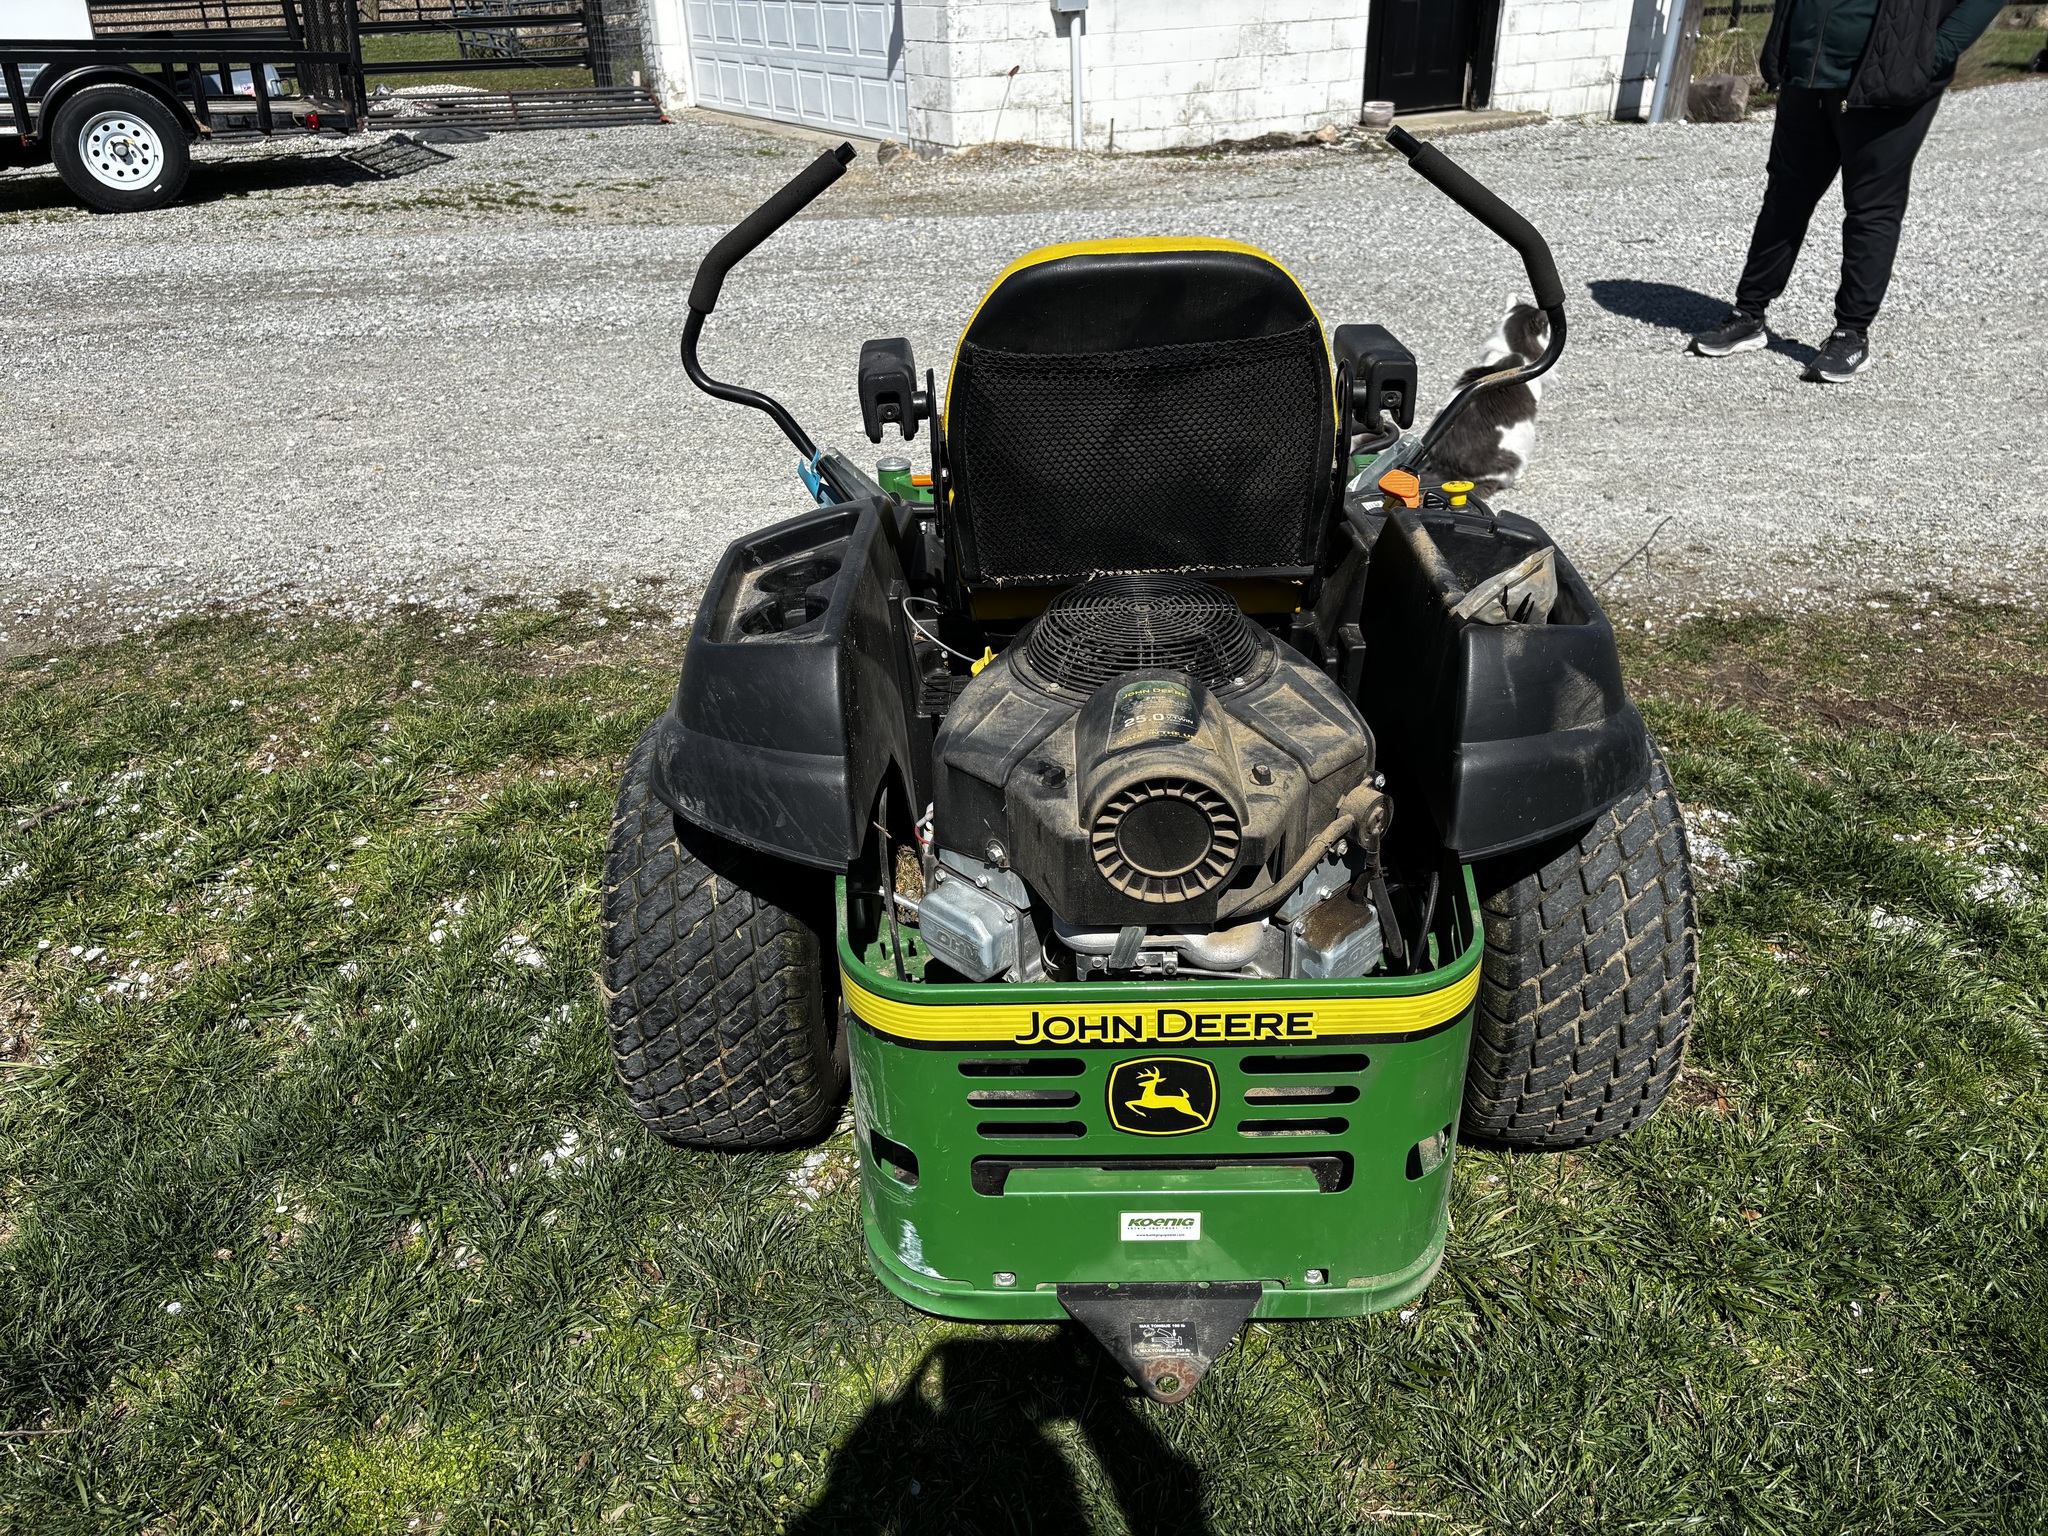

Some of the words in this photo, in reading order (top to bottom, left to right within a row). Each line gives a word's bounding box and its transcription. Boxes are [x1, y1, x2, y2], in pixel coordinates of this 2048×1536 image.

[1123, 688, 1150, 699] JOHN
[1153, 688, 1188, 698] DEERE
[1124, 713, 1165, 728] 25.0
[1014, 1010, 1145, 1043] JOHN
[1156, 1008, 1315, 1040] DEERE
